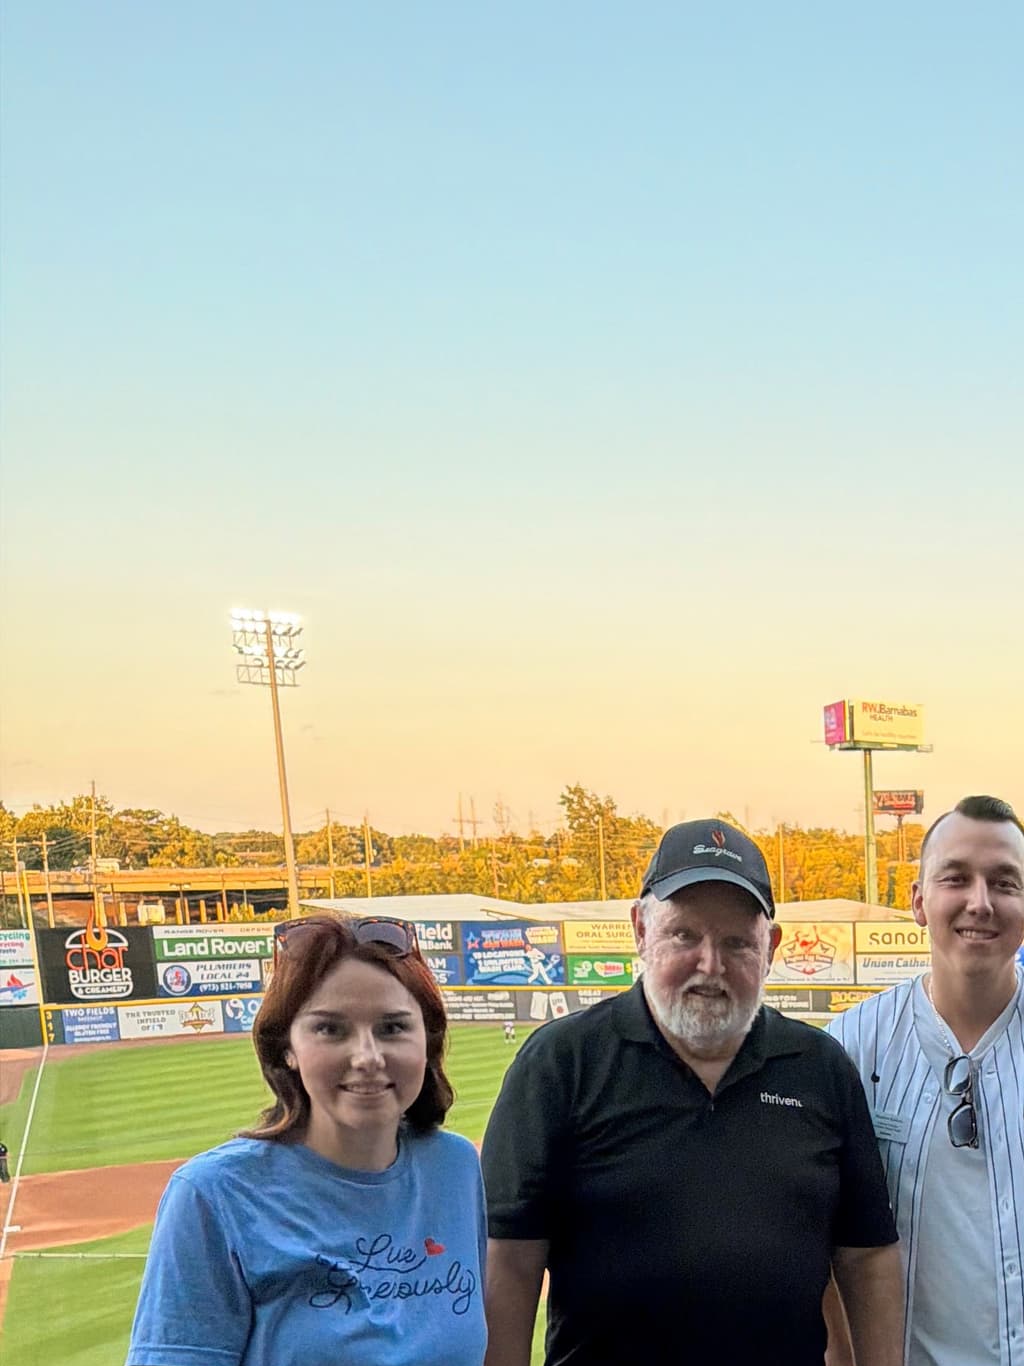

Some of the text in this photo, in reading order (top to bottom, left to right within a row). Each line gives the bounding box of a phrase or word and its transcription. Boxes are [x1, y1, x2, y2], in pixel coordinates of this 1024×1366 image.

[576, 930, 603, 938] ORAL
[65, 934, 128, 969] char
[162, 938, 209, 956] Land
[211, 938, 265, 955] Rover
[196, 963, 252, 972] PLUMBERS
[862, 957, 894, 968] Union
[69, 967, 132, 984] BURGER
[200, 971, 232, 980] LOCAL
[85, 985, 127, 994] CREAMERY
[65, 1007, 115, 1017] TWO FIELDS
